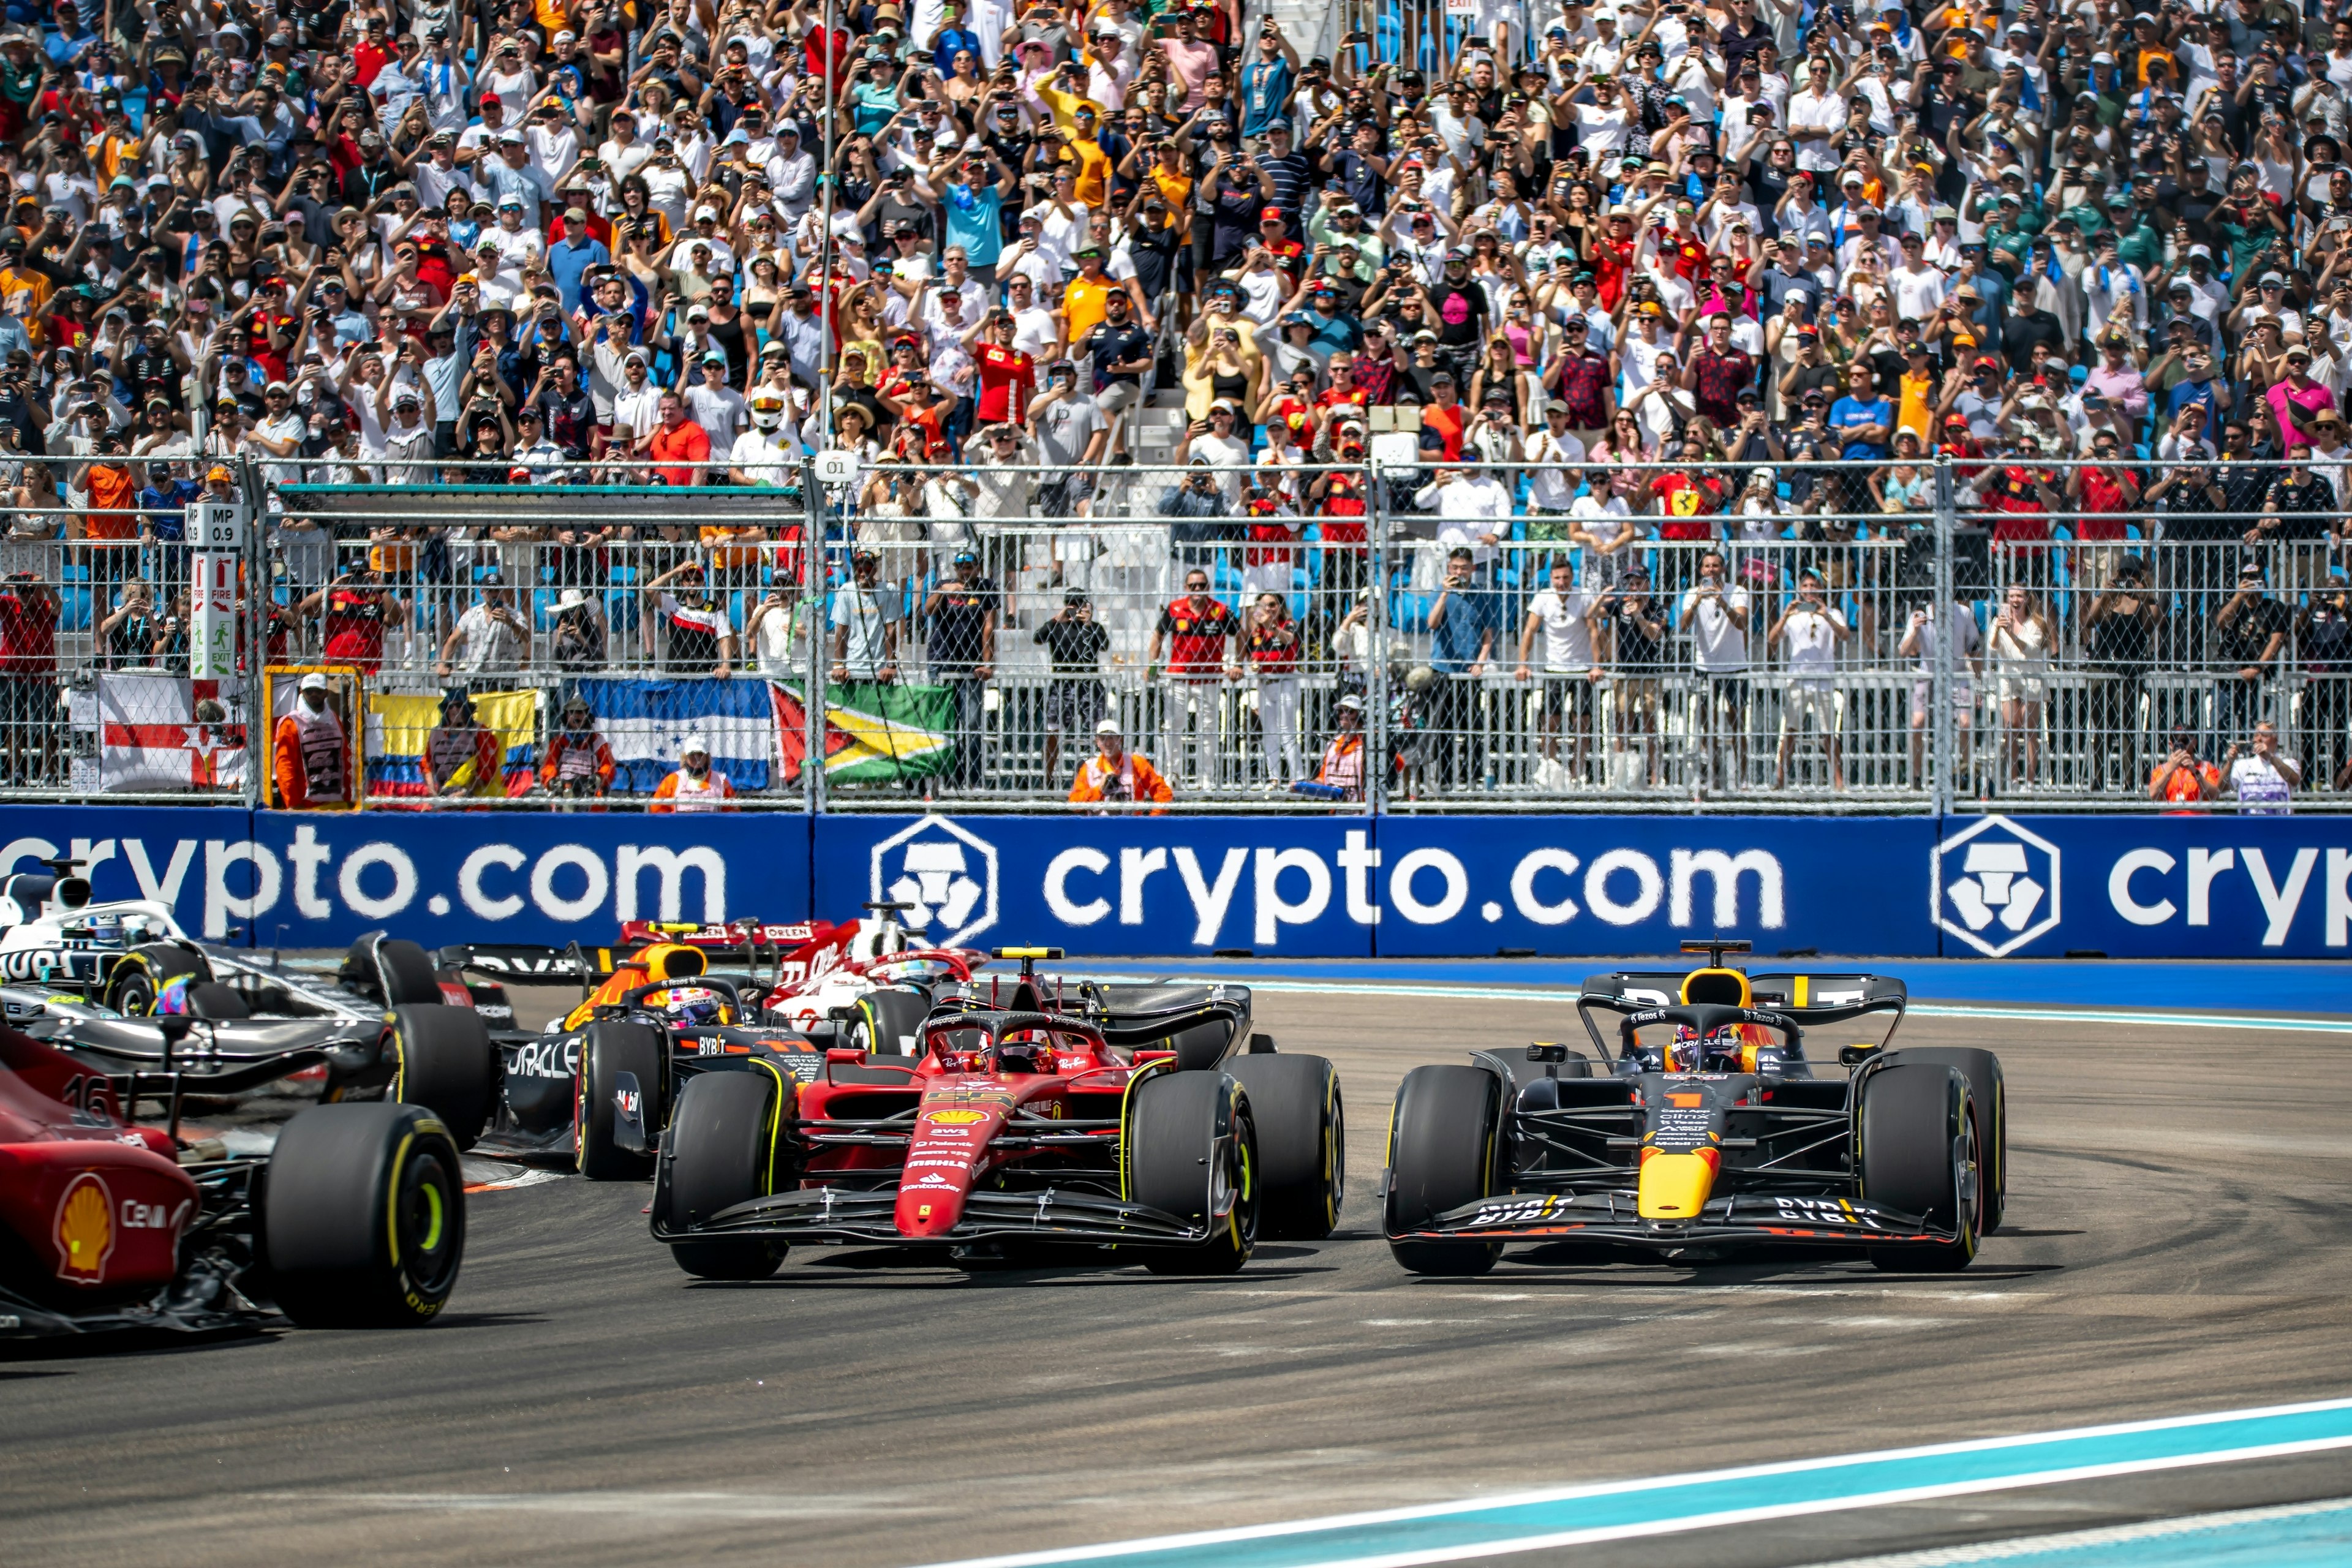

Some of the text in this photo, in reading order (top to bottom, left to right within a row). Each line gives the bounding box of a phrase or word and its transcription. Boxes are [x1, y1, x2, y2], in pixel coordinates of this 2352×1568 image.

[826, 461, 845, 474] 01
[213, 509, 233, 524] MP
[189, 527, 198, 541] 0.9
[212, 527, 233, 541] 0.9
[194, 589, 204, 600] FIRE
[211, 590, 231, 600] FIRE
[192, 652, 203, 662] EXIT
[211, 653, 231, 662] EXIT
[1042, 826, 1785, 947] crypto.com
[768, 928, 807, 937] ORLEN
[931, 1016, 962, 1027] Snapdragon
[1054, 1016, 1090, 1029] Snapdragon
[1637, 1012, 1657, 1022] Tezos
[1752, 1012, 1775, 1023] Tezos
[699, 1033, 726, 1055] BYBIT
[942, 1055, 970, 1068] Ray-Ban
[1057, 1057, 1087, 1069] Ray-Ban
[62, 1073, 116, 1129] 16
[616, 1090, 639, 1112] Mobil
[922, 1091, 1017, 1109] 55
[1662, 1093, 1703, 1108] 1
[907, 1159, 968, 1169] MAHLE
[900, 1183, 962, 1193] Santander
